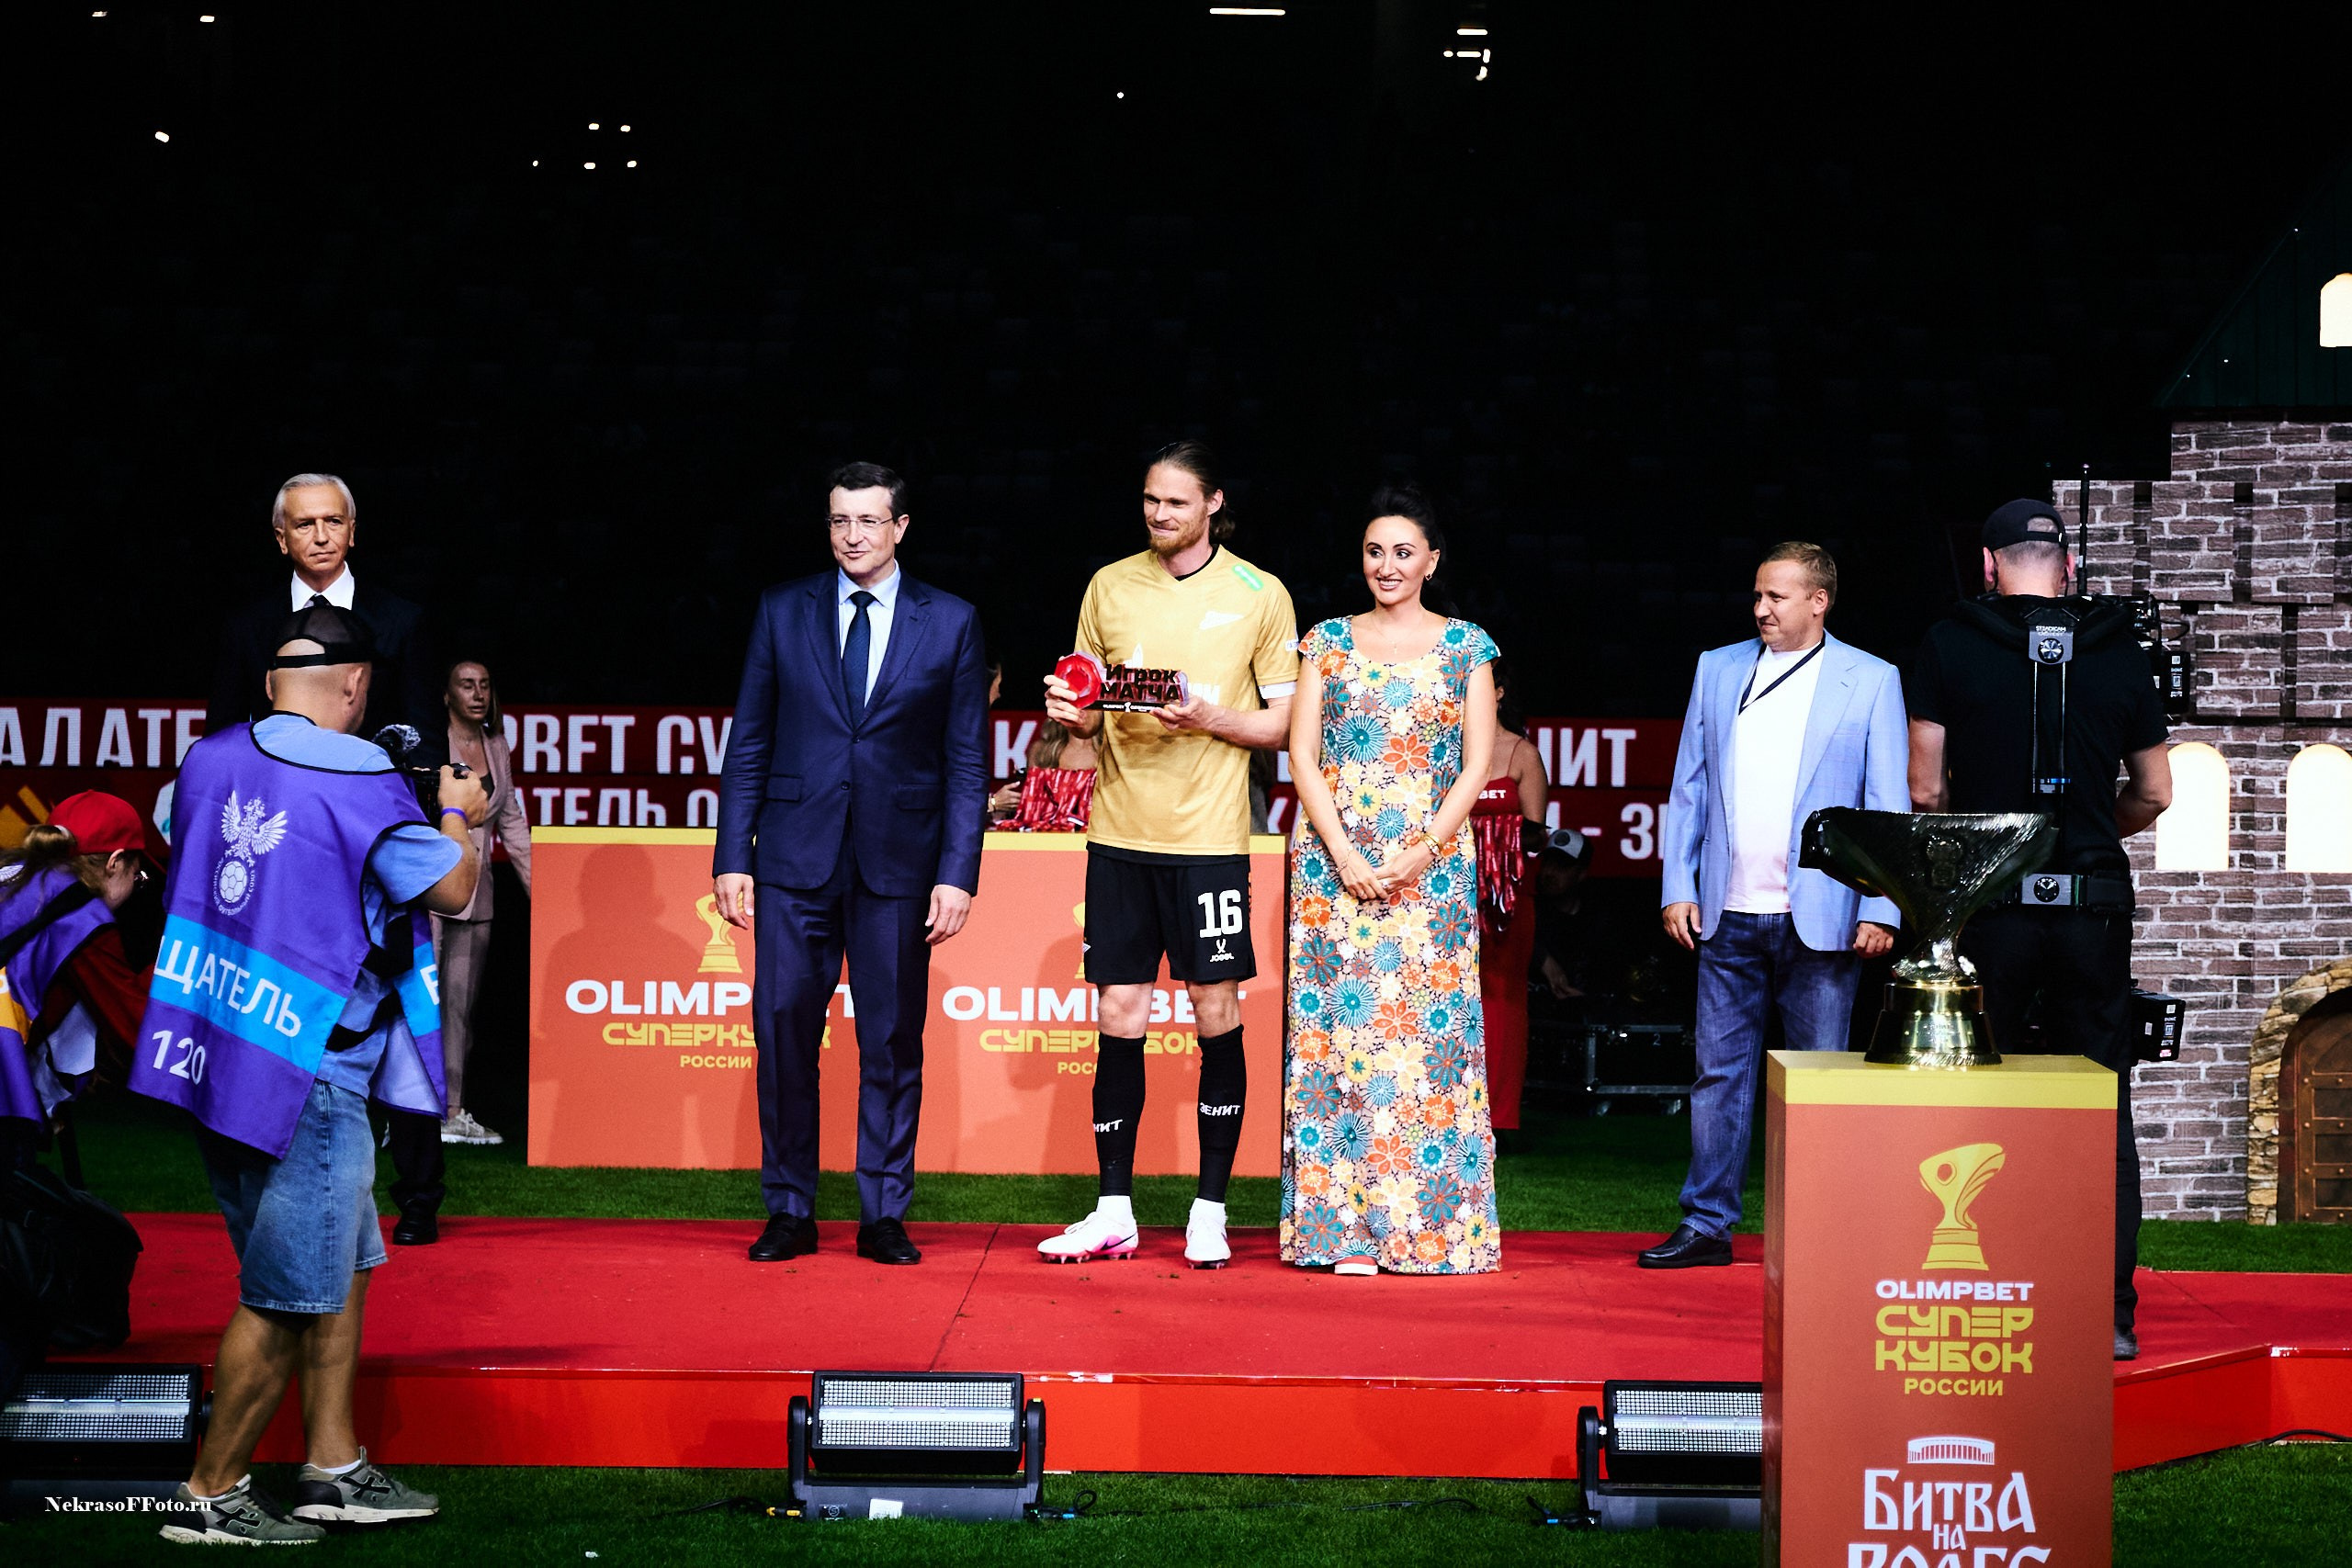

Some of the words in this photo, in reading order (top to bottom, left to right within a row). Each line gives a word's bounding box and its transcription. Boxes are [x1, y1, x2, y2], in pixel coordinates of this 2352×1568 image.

[1100, 682, 1182, 701] МАТЧА
[1197, 889, 1243, 938] 16
[602, 1022, 831, 1049] СУПЕРКУ
[152, 1029, 206, 1086] 120
[680, 1055, 752, 1068] РОССИИ
[1057, 1061, 1098, 1075] РОС
[1200, 1102, 1240, 1116] ЗЕНИТ
[1875, 1280, 2034, 1301] OLIMPBET
[1875, 1305, 2034, 1338] СУПЕР
[1875, 1340, 2033, 1373] КУБОК
[1905, 1379, 2004, 1396] РОССИИ
[1933, 1524, 1967, 1551] НА
